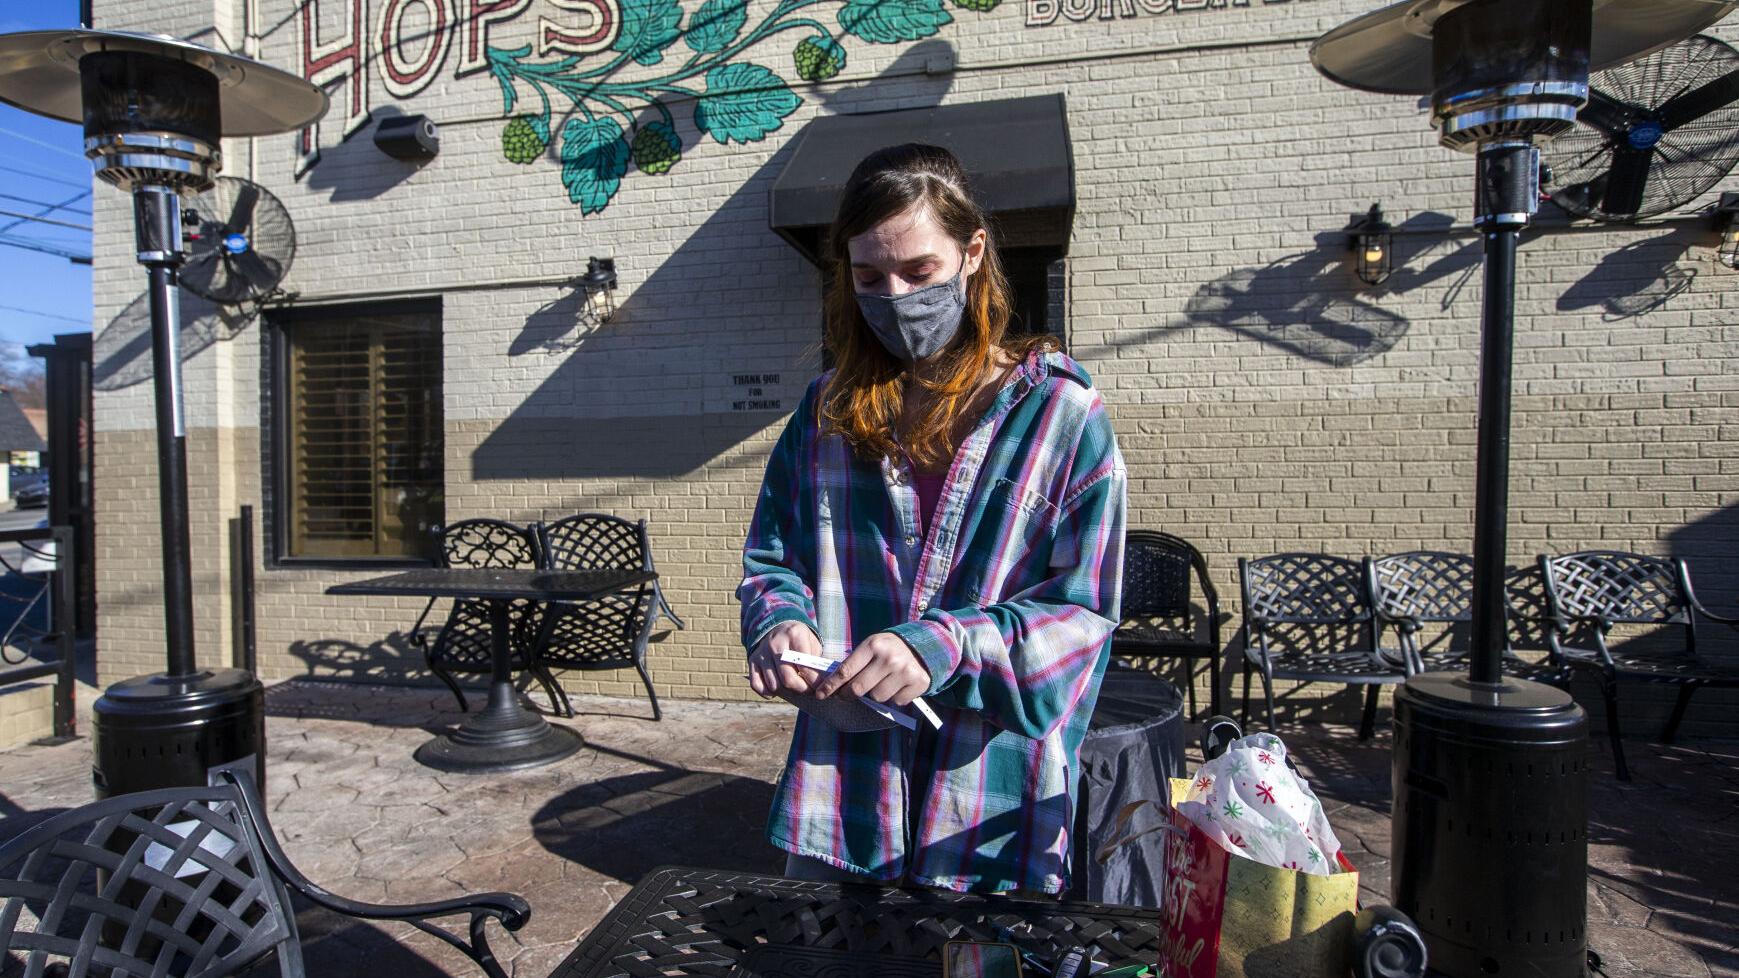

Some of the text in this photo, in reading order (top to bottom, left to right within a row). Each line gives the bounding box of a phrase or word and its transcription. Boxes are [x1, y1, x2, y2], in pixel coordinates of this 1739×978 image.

[733, 373, 780, 385] THANK YOU
[748, 387, 762, 397] FOR
[732, 399, 781, 410] NOT SMOKING
